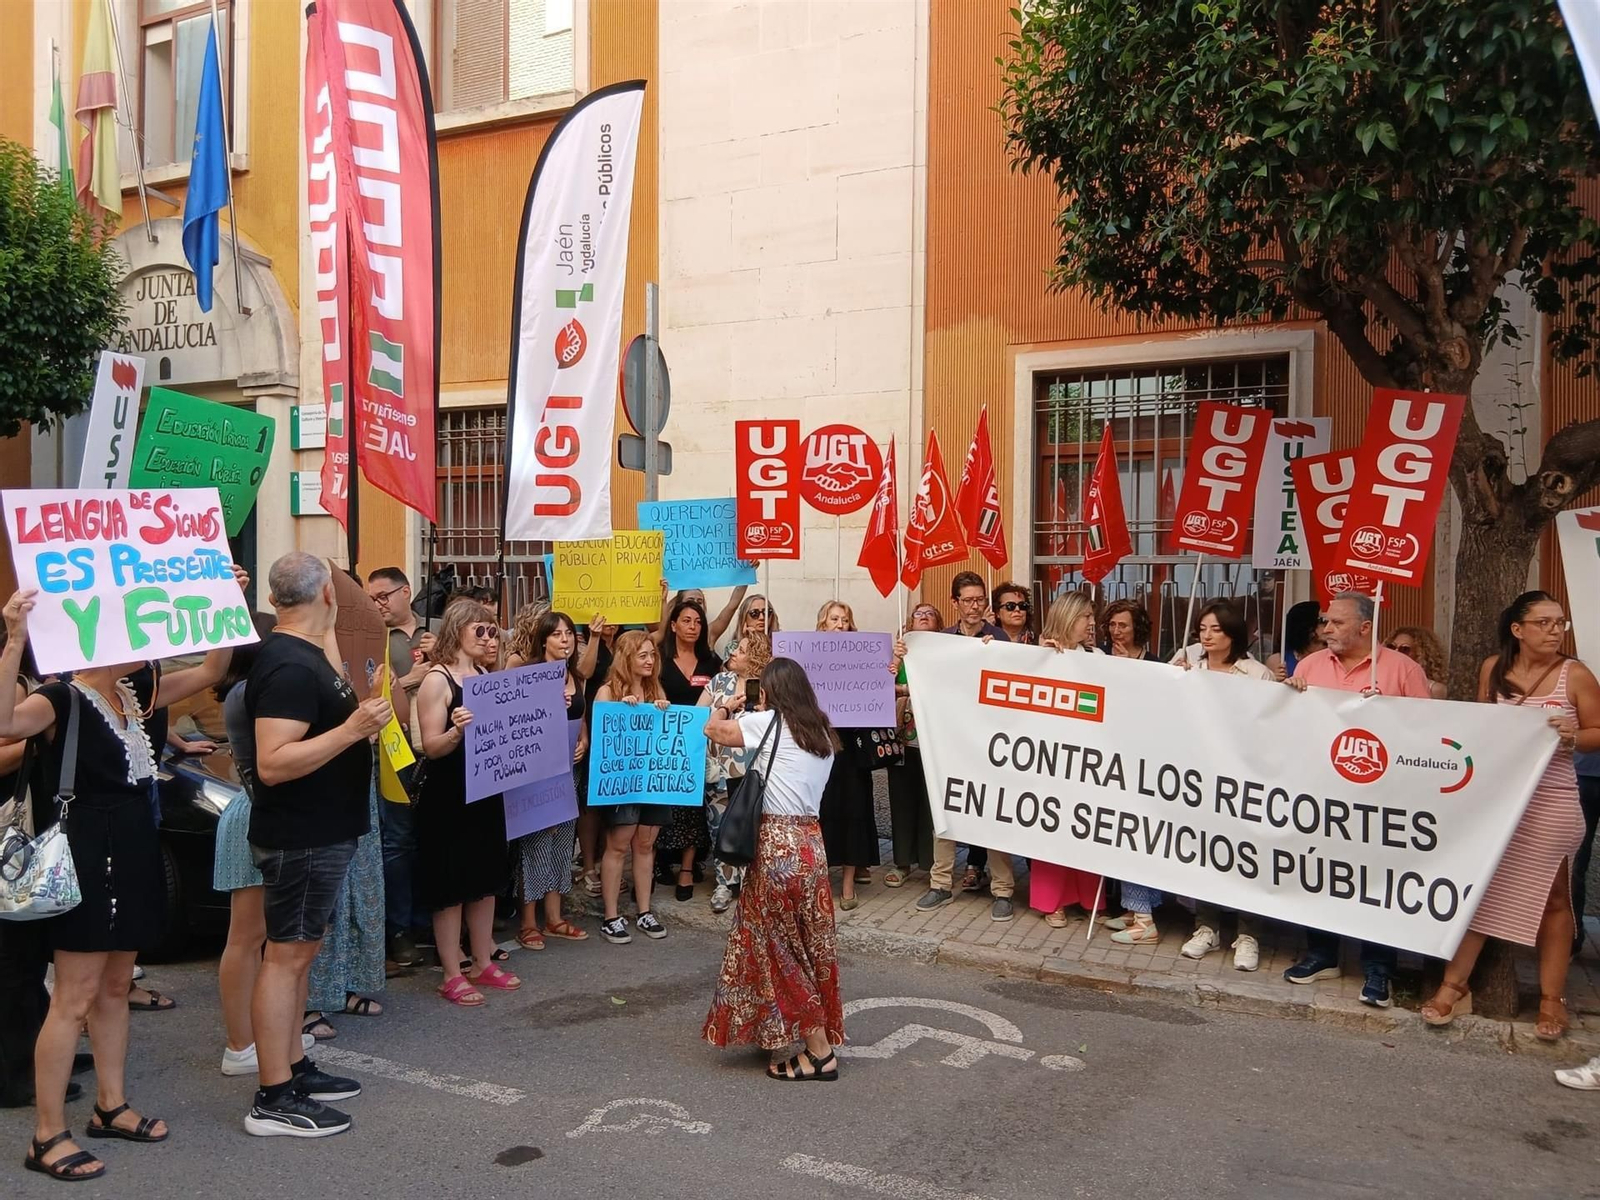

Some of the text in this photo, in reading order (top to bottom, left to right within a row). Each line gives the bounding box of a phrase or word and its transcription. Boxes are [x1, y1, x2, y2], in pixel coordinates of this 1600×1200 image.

[597, 123, 613, 195] Públicos
[554, 224, 574, 276] Jaén
[136, 272, 195, 301] JUNTA
[154, 300, 178, 326] DE
[806, 434, 868, 467] UGT
[1198, 410, 1256, 512] UGT
[748, 426, 788, 520] UGT
[1371, 399, 1446, 528] UGT
[814, 492, 861, 505] Andalucía
[15, 498, 128, 544] LENGUA
[129, 492, 152, 510] DE
[650, 504, 737, 522] QUEREMOS
[1186, 515, 1207, 528] UGT
[1211, 519, 1227, 528] FSP
[770, 526, 783, 534] FSP
[1355, 531, 1381, 547] UGT
[664, 539, 695, 556] AÉN,
[697, 542, 714, 556] NO
[1387, 537, 1406, 548] FSP
[35, 543, 235, 594] ES PRESENTE
[559, 550, 607, 567] PÚBLICA
[616, 551, 661, 565] PRIVADA
[633, 571, 644, 589] 1
[606, 596, 617, 608] LA
[62, 587, 251, 661] Y FUTURO
[777, 640, 882, 654] SIN MEDIADORES
[804, 662, 823, 671] HAY
[986, 678, 1077, 711] CCOO
[828, 699, 884, 713] INCLUSIÓN
[603, 710, 694, 735] POR UNA FP
[499, 735, 508, 746] DE
[511, 726, 543, 741] ESPERA
[602, 731, 687, 759] PÚBLICA
[509, 742, 541, 760] OFERTA
[1337, 735, 1458, 771] UGT Andalucía
[600, 757, 691, 774] QUE NO DEJE A
[598, 770, 697, 796] NADIE ATRÁS
[988, 732, 1438, 852] CONTRA LOS RECORTES
[943, 777, 1473, 922] EN LOS SERVICIOS PÚBLICO
